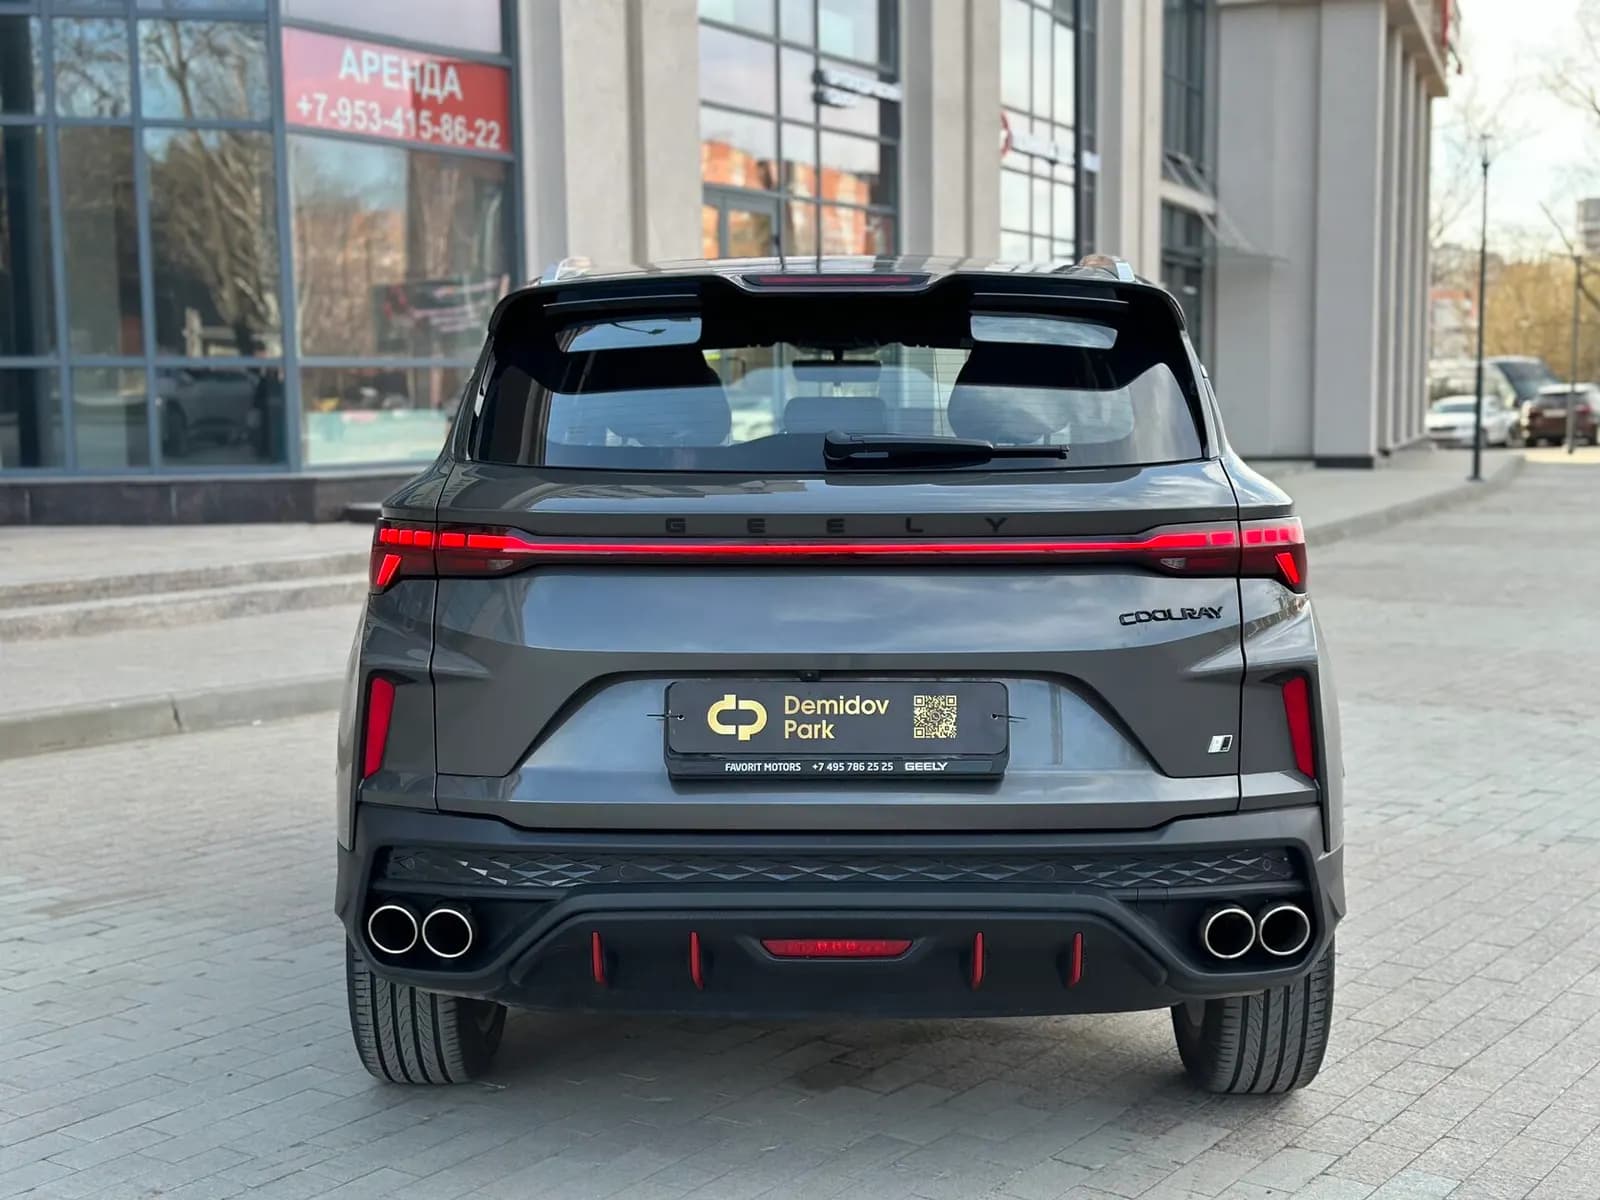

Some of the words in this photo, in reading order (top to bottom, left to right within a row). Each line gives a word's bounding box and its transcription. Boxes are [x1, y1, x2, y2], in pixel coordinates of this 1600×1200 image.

[338, 44, 463, 103] АРЕНДА
[296, 93, 502, 150] +7-953-415-86-22
[665, 517, 1007, 534] GEELY
[1118, 606, 1224, 626] COOLRAY
[784, 695, 889, 715] Demidov
[784, 719, 835, 740] Park
[725, 762, 763, 772] FAVORIT
[764, 762, 802, 772] MOTORS
[812, 762, 825, 772] +7
[826, 762, 845, 772] 495
[847, 762, 866, 772] 786
[867, 762, 880, 772] 25
[881, 762, 894, 772] 25
[904, 762, 949, 771] GEELY
